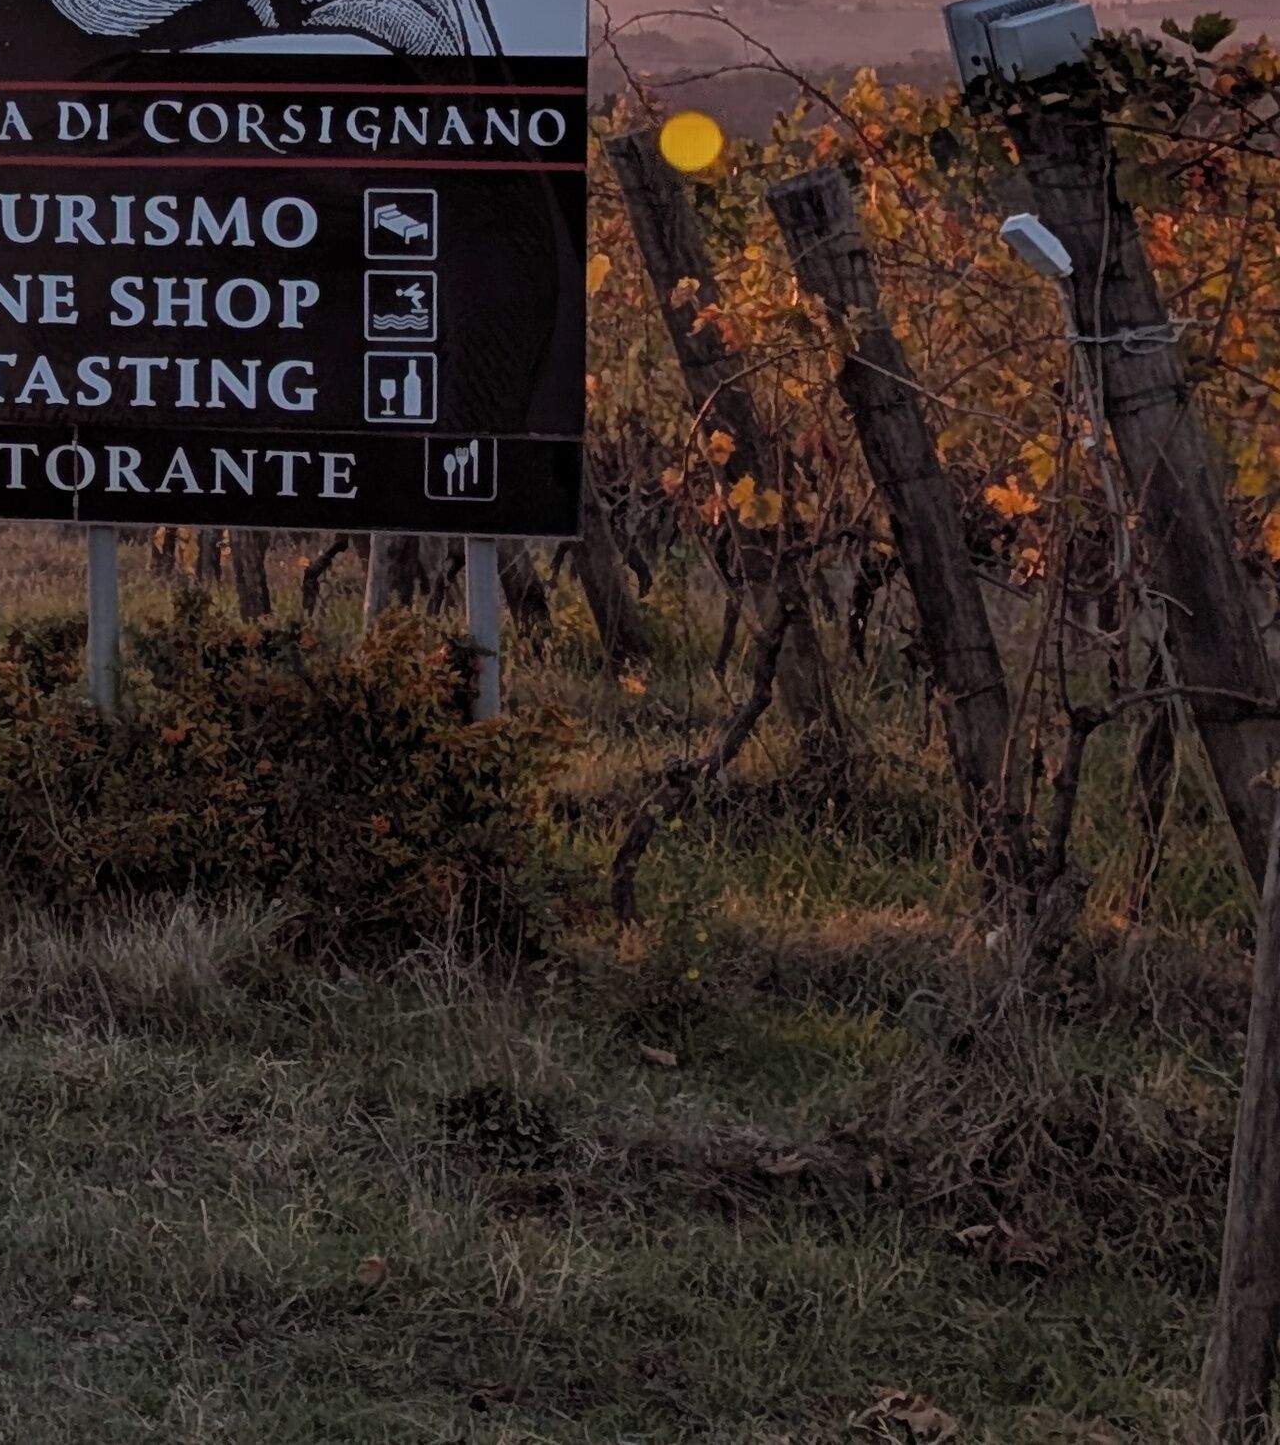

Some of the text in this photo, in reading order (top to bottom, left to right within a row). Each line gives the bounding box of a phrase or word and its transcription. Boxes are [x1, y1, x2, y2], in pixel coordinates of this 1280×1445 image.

[57, 101, 109, 141] DI
[143, 100, 566, 152] CORSIGNANO
[110, 276, 320, 329] SHOP
